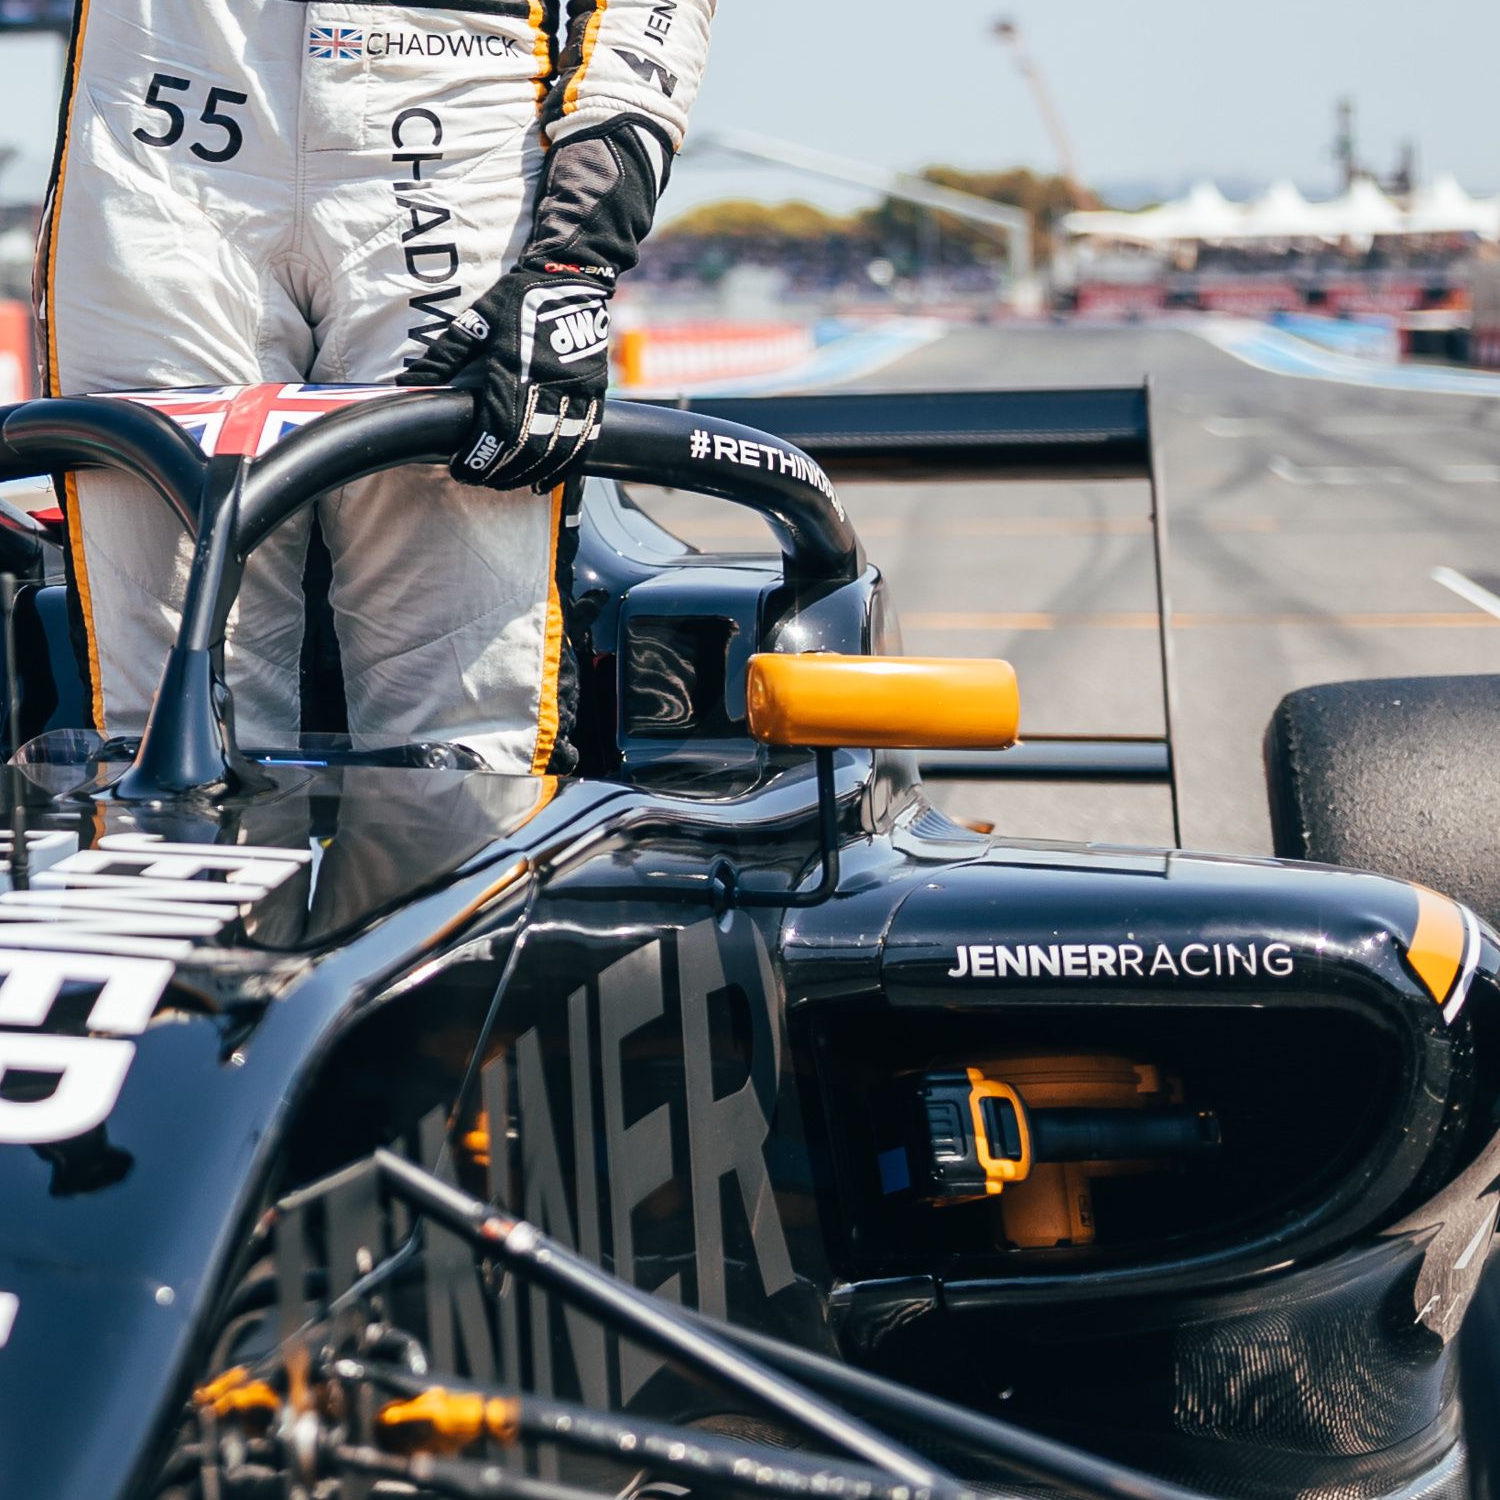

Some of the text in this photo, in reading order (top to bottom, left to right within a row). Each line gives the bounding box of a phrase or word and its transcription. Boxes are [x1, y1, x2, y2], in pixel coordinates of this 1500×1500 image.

[365, 32, 520, 59] CHADWICK
[132, 73, 249, 163] 55
[469, 434, 500, 470] OMP
